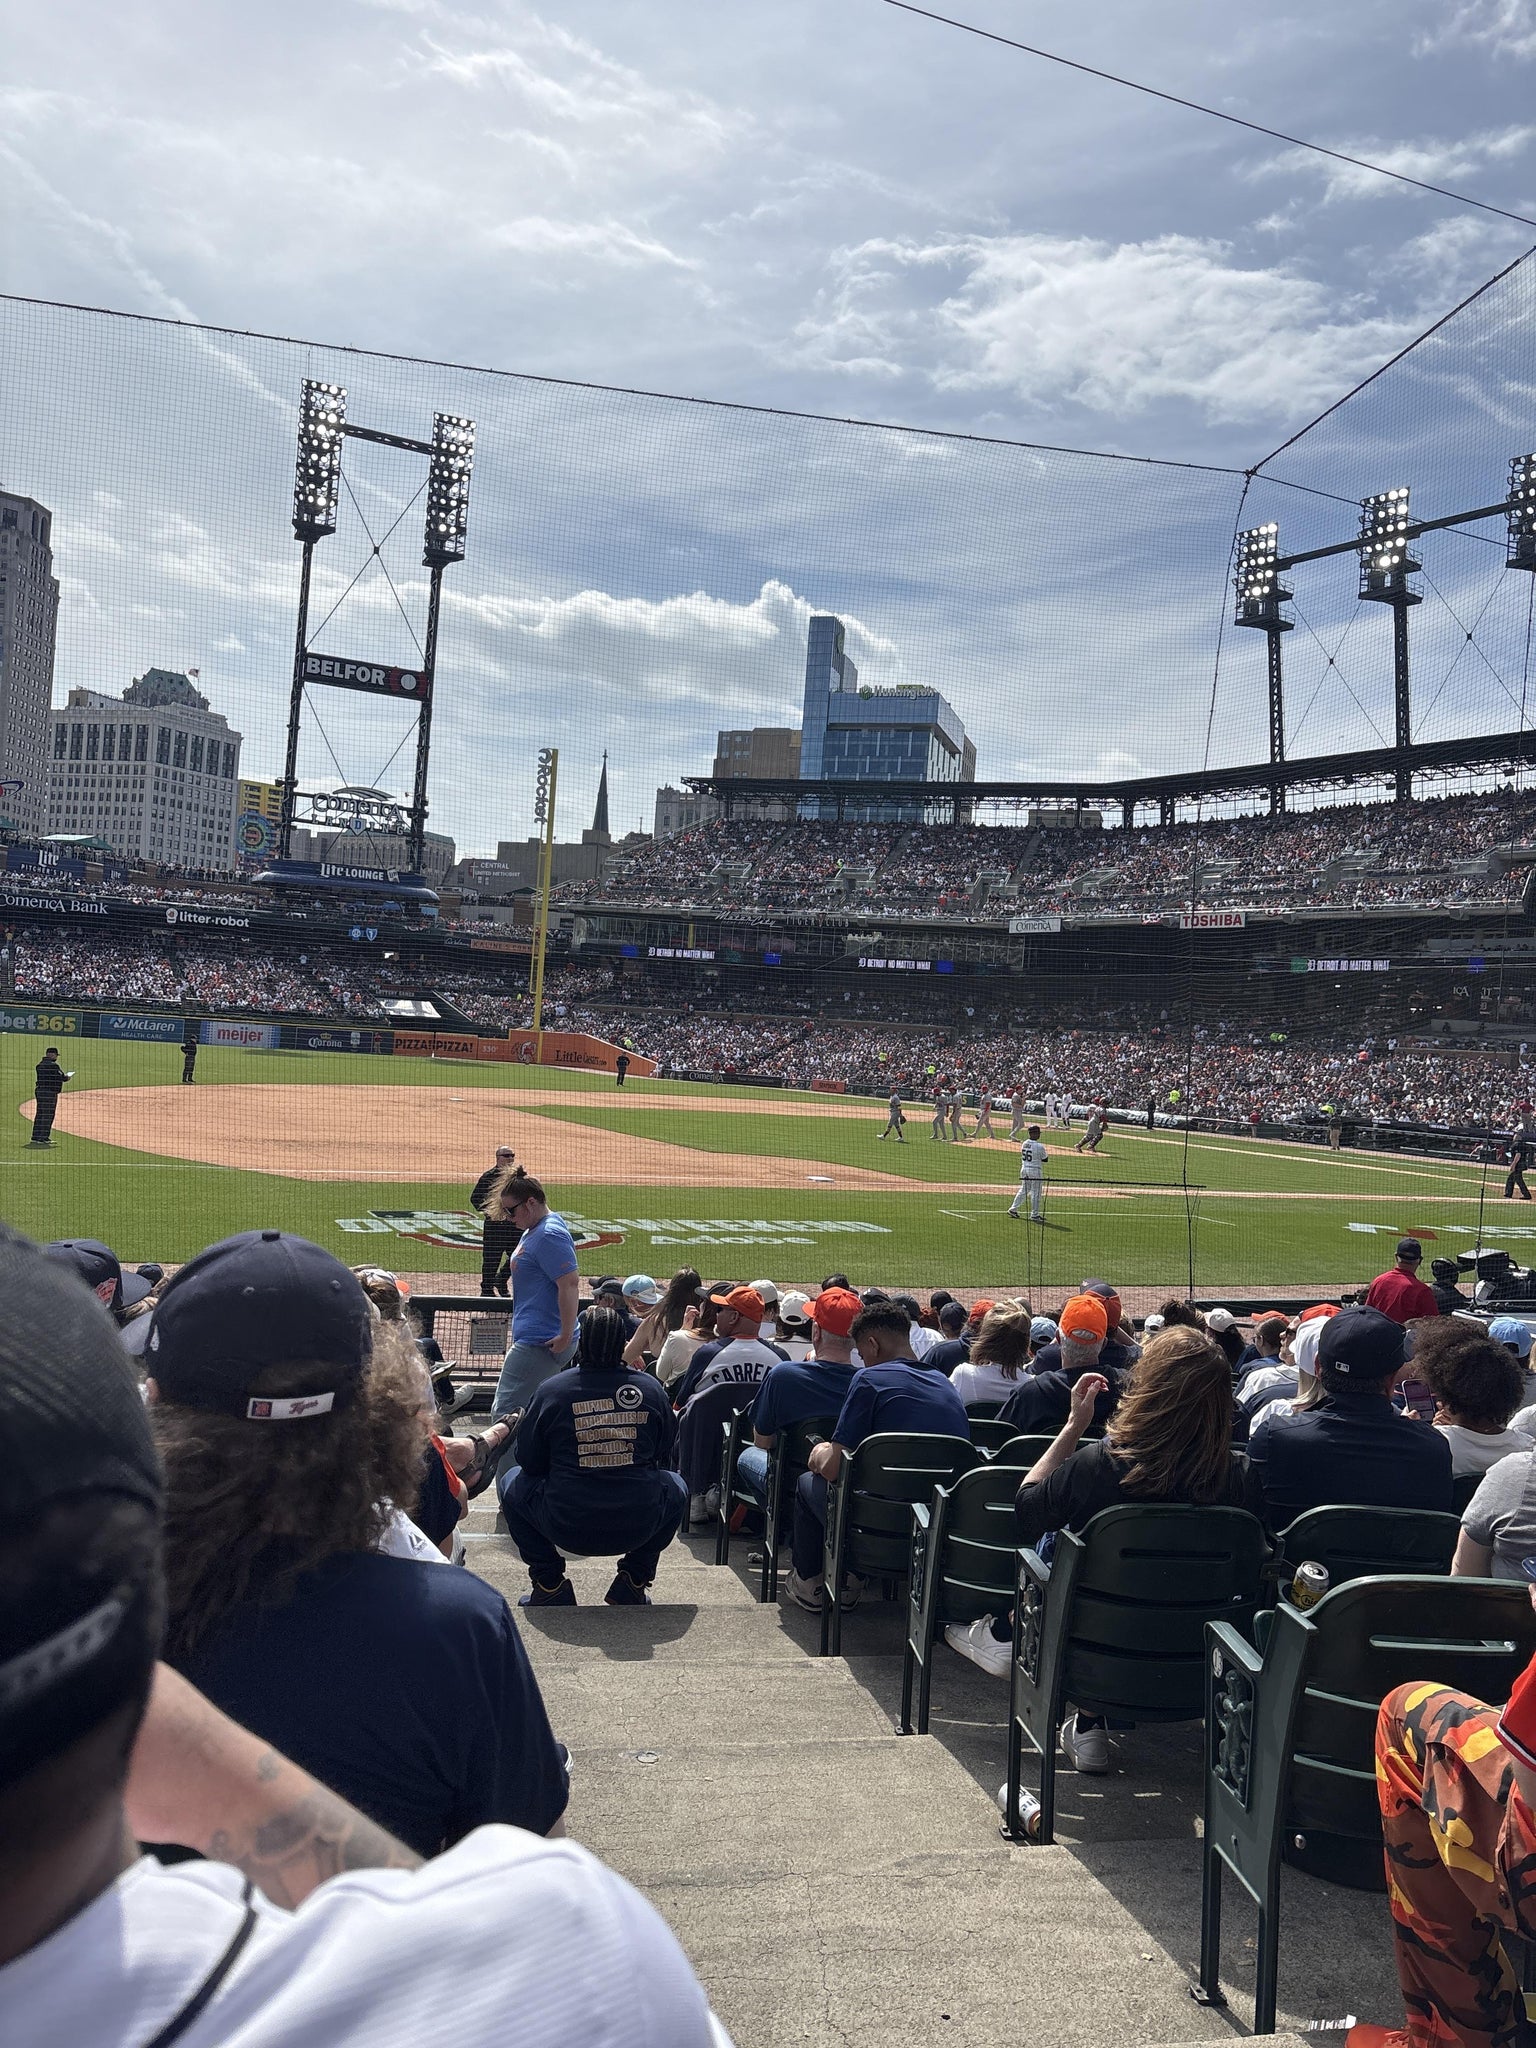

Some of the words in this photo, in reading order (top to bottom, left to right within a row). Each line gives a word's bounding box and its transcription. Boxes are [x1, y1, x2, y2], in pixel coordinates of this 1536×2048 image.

[306, 657, 386, 685] BELFOR
[874, 685, 936, 700] Huntington
[38, 849, 59, 868] Lite
[320, 863, 344, 878] Lite
[345, 867, 384, 880] LOUNGE
[70, 900, 109, 915] Bank
[1182, 914, 1242, 927] TOSHIBA
[656, 948, 675, 957] DETROIT
[675, 949, 683, 958] NO
[683, 949, 701, 959] MATTER
[701, 950, 716, 960] WHAT
[867, 958, 887, 968] DETROIT
[888, 959, 896, 968] NO
[896, 960, 916, 969] MATTER
[916, 961, 931, 970] WHAT
[1317, 960, 1339, 971] DETROIT
[1340, 960, 1349, 971] NO
[1349, 960, 1372, 971] MATTER
[1373, 960, 1390, 971] WHAT
[0, 1012, 76, 1033] bet365
[127, 1018, 175, 1032] McLaren
[217, 1026, 264, 1044] meijer
[308, 1037, 344, 1049] Corona
[555, 1050, 583, 1063] Little
[1022, 1149, 1033, 1162] 56
[572, 1398, 615, 1415] UNIFYING
[575, 1411, 637, 1430] NATIONALITIES
[636, 1411, 649, 1424] BY
[575, 1427, 638, 1442] ENCOURAGING
[578, 1440, 627, 1455] EDUCATION
